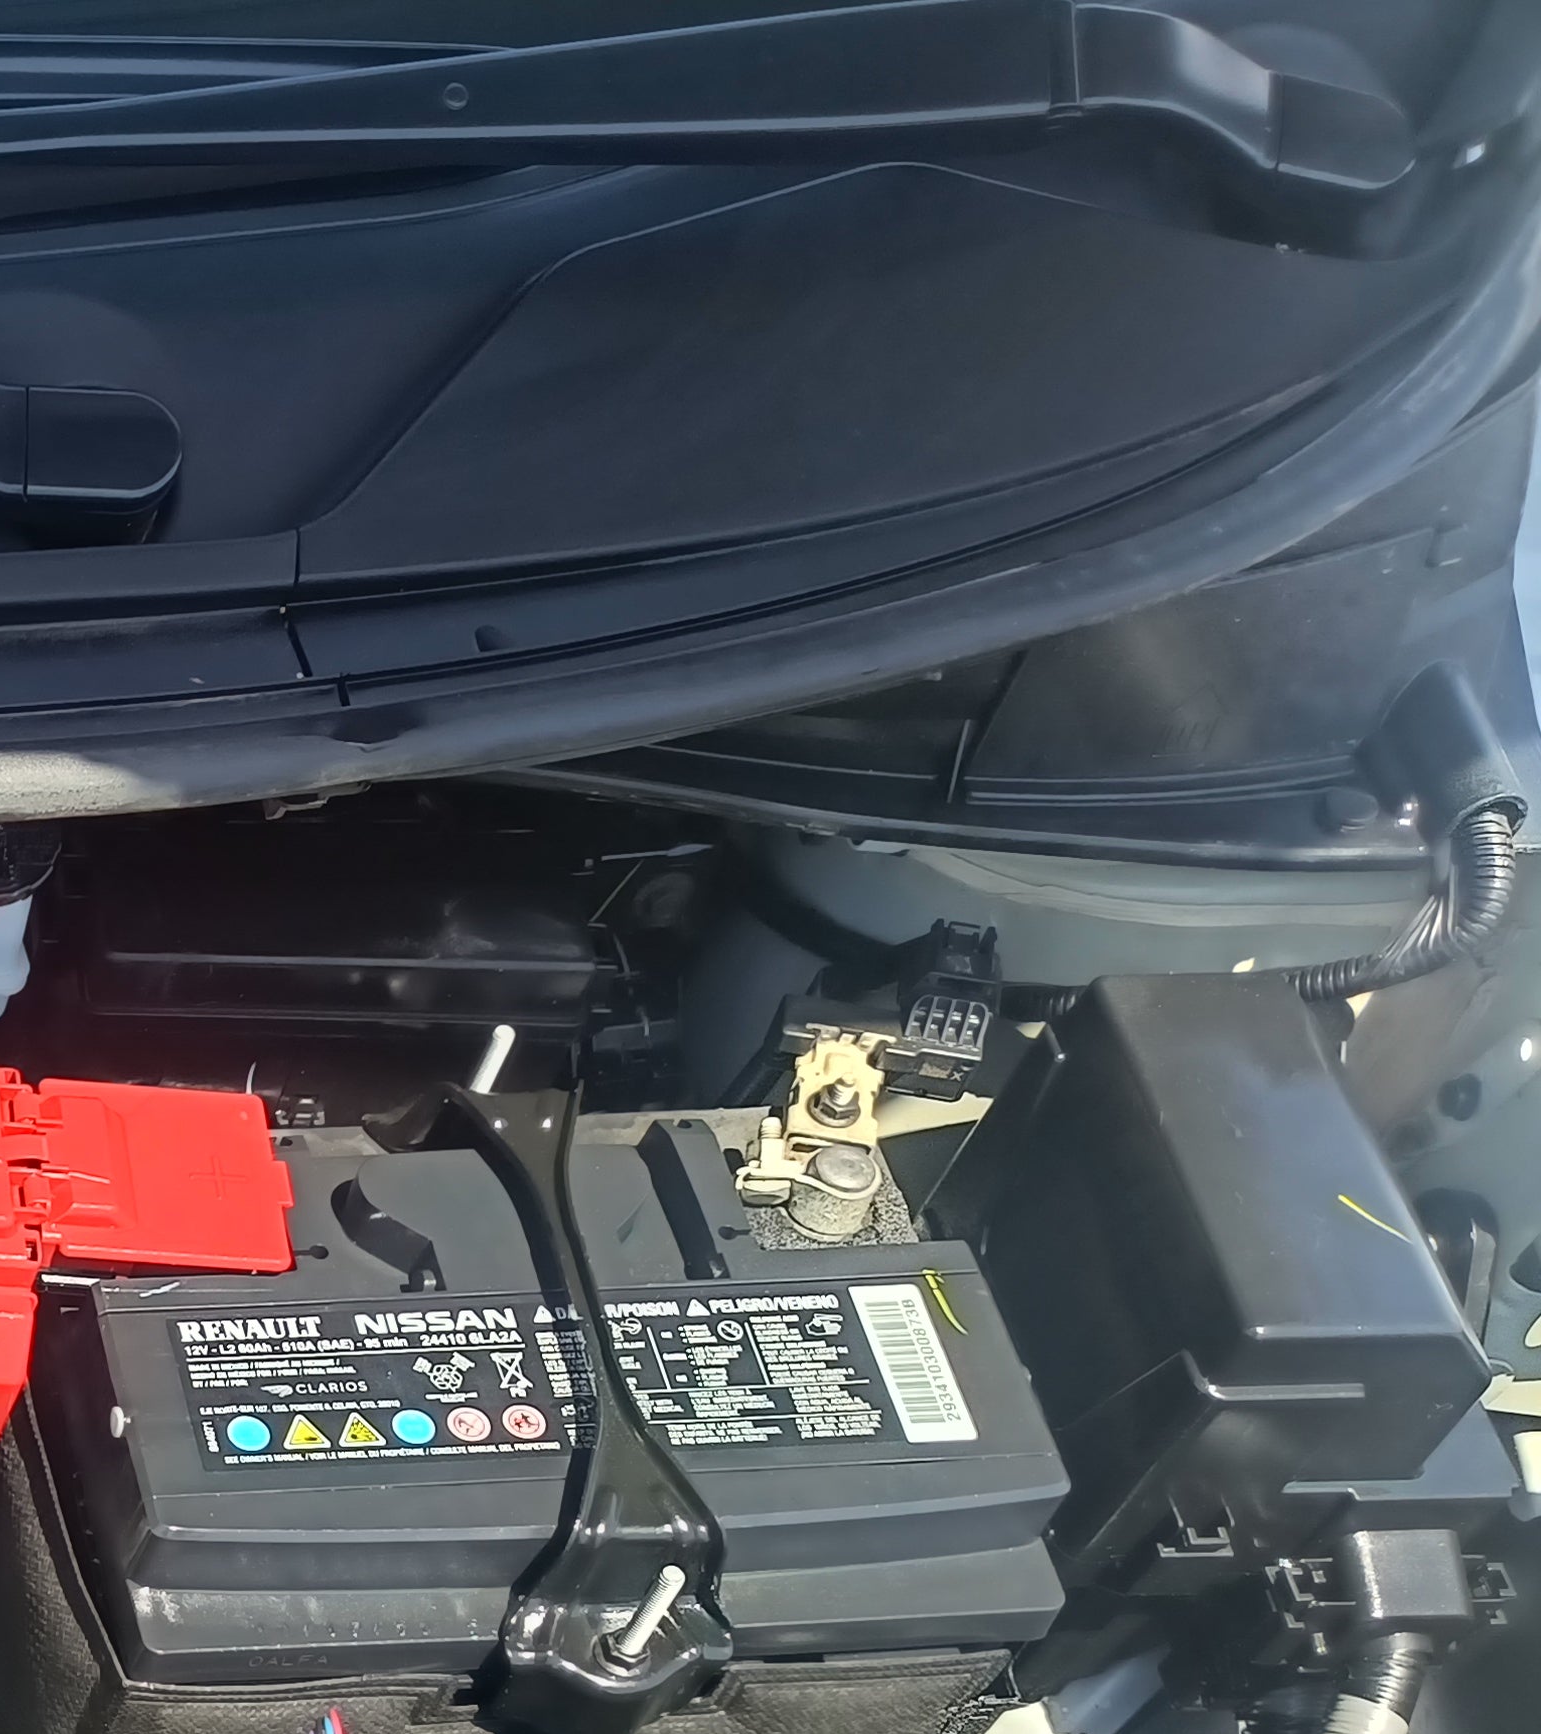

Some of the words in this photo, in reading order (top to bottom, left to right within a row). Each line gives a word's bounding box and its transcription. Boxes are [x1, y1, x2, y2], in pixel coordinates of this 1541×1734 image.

[708, 1294, 839, 1314] PELIGRO/VENENO
[176, 1315, 322, 1343] RENAULT
[354, 1307, 518, 1335] NISSAN
[184, 1344, 209, 1356] 12V
[219, 1343, 237, 1355] L2
[317, 1338, 355, 1352] (SAE)
[383, 1336, 409, 1348] min
[419, 1332, 467, 1347] 24410
[295, 1381, 368, 1395] CLARIOS
